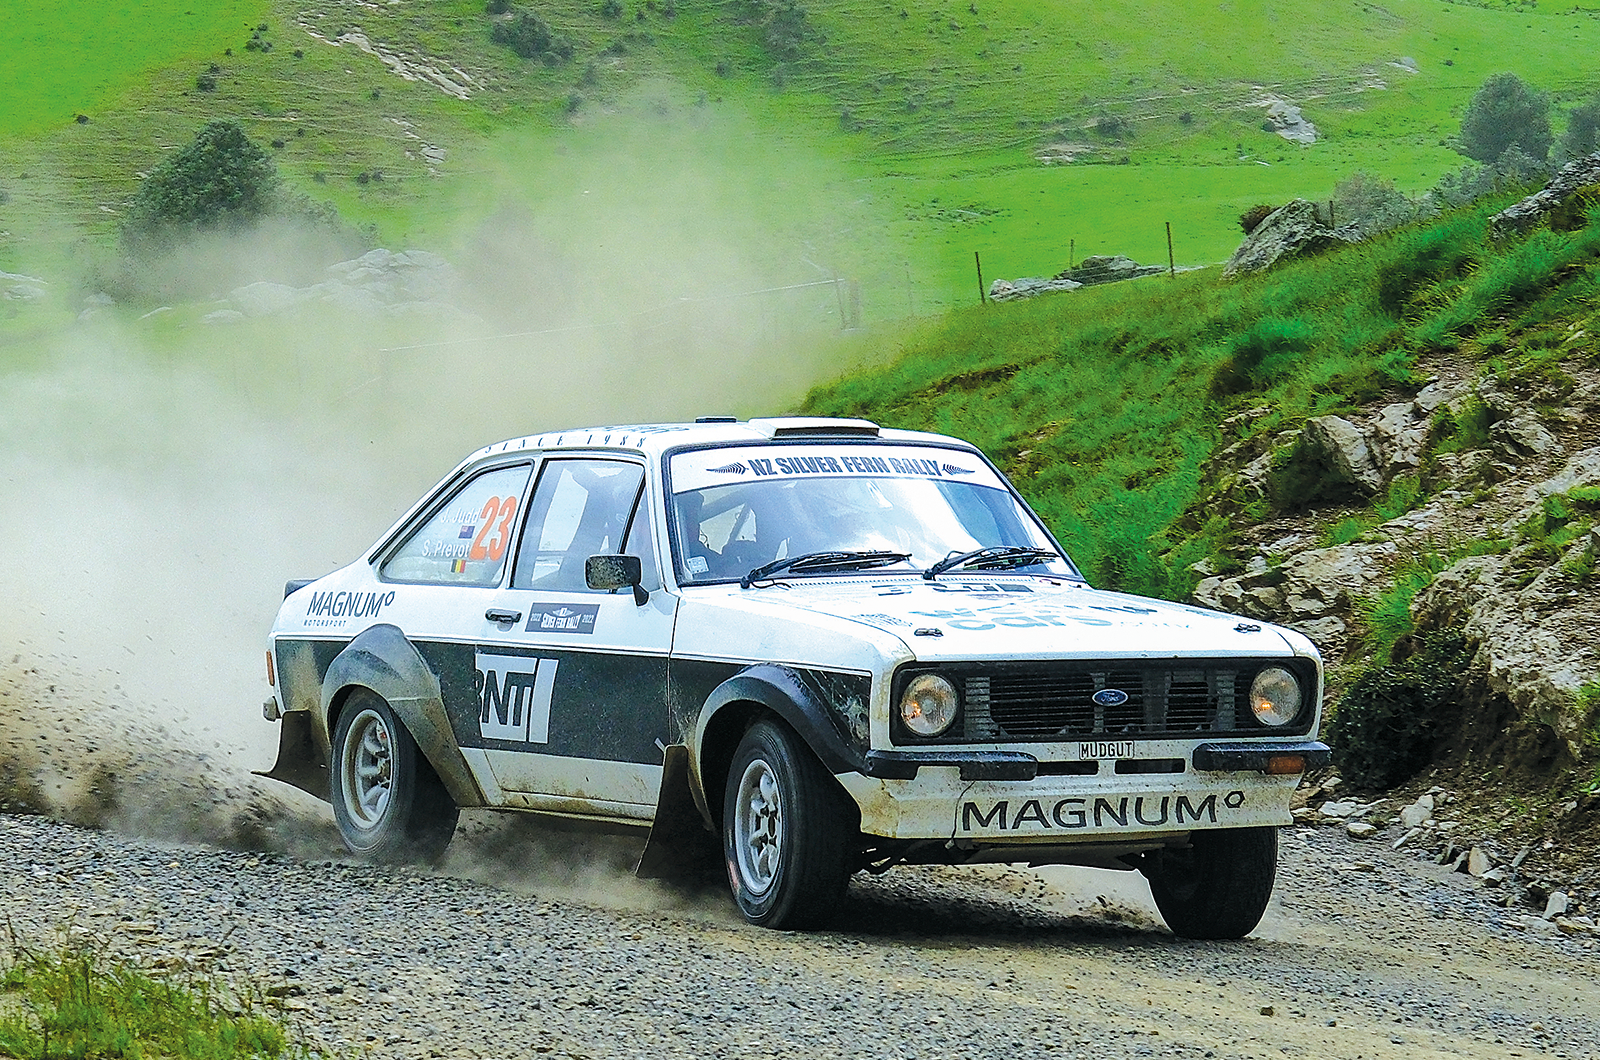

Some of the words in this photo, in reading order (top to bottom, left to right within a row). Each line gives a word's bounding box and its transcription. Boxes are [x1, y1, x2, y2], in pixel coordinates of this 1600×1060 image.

[748, 459, 778, 476] NZ
[775, 456, 843, 475] SILVER
[840, 456, 891, 473] FERN
[888, 457, 942, 477] RALLY
[468, 495, 517, 561] 23
[421, 539, 432, 557] S.
[433, 540, 470, 558] Prevot
[303, 619, 347, 628] MOTORSPORT
[1081, 742, 1133, 758] MUDGUT
